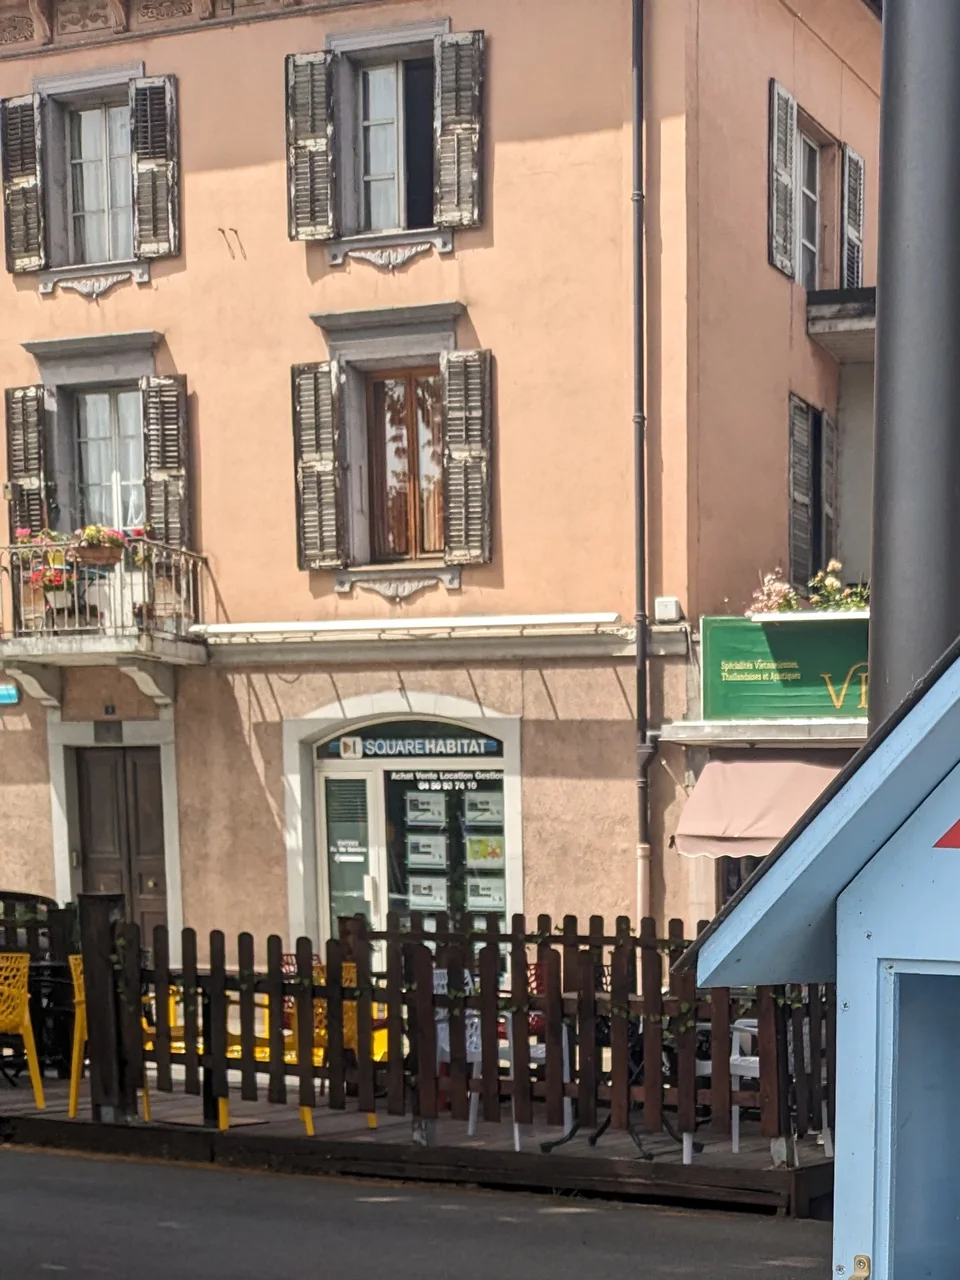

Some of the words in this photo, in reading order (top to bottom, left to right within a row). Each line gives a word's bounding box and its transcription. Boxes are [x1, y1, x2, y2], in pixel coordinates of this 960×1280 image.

[762, 672, 769, 681] et
[391, 772, 414, 781] Achat
[415, 772, 437, 781] Vente
[439, 772, 473, 781] Location
